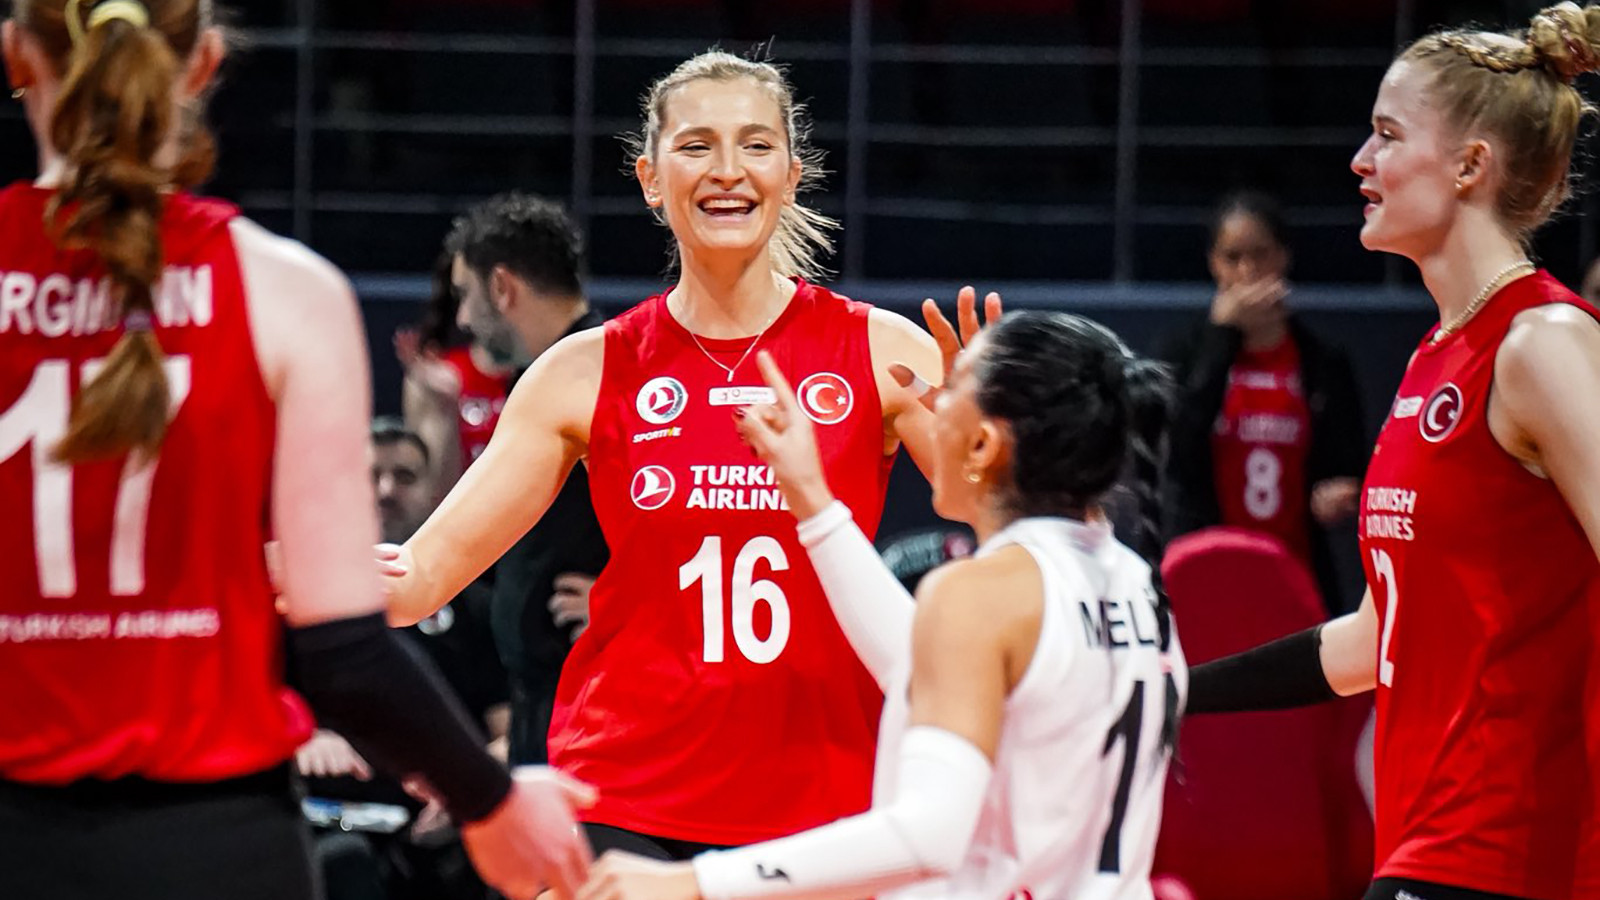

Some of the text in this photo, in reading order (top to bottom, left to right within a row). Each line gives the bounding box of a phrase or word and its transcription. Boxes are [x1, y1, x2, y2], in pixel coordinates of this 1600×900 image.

[686, 488, 791, 511] AIRLIN
[690, 464, 779, 486] TURKI
[1244, 448, 1280, 520] 8
[678, 535, 791, 664] 16
[1078, 597, 1158, 650] MEL
